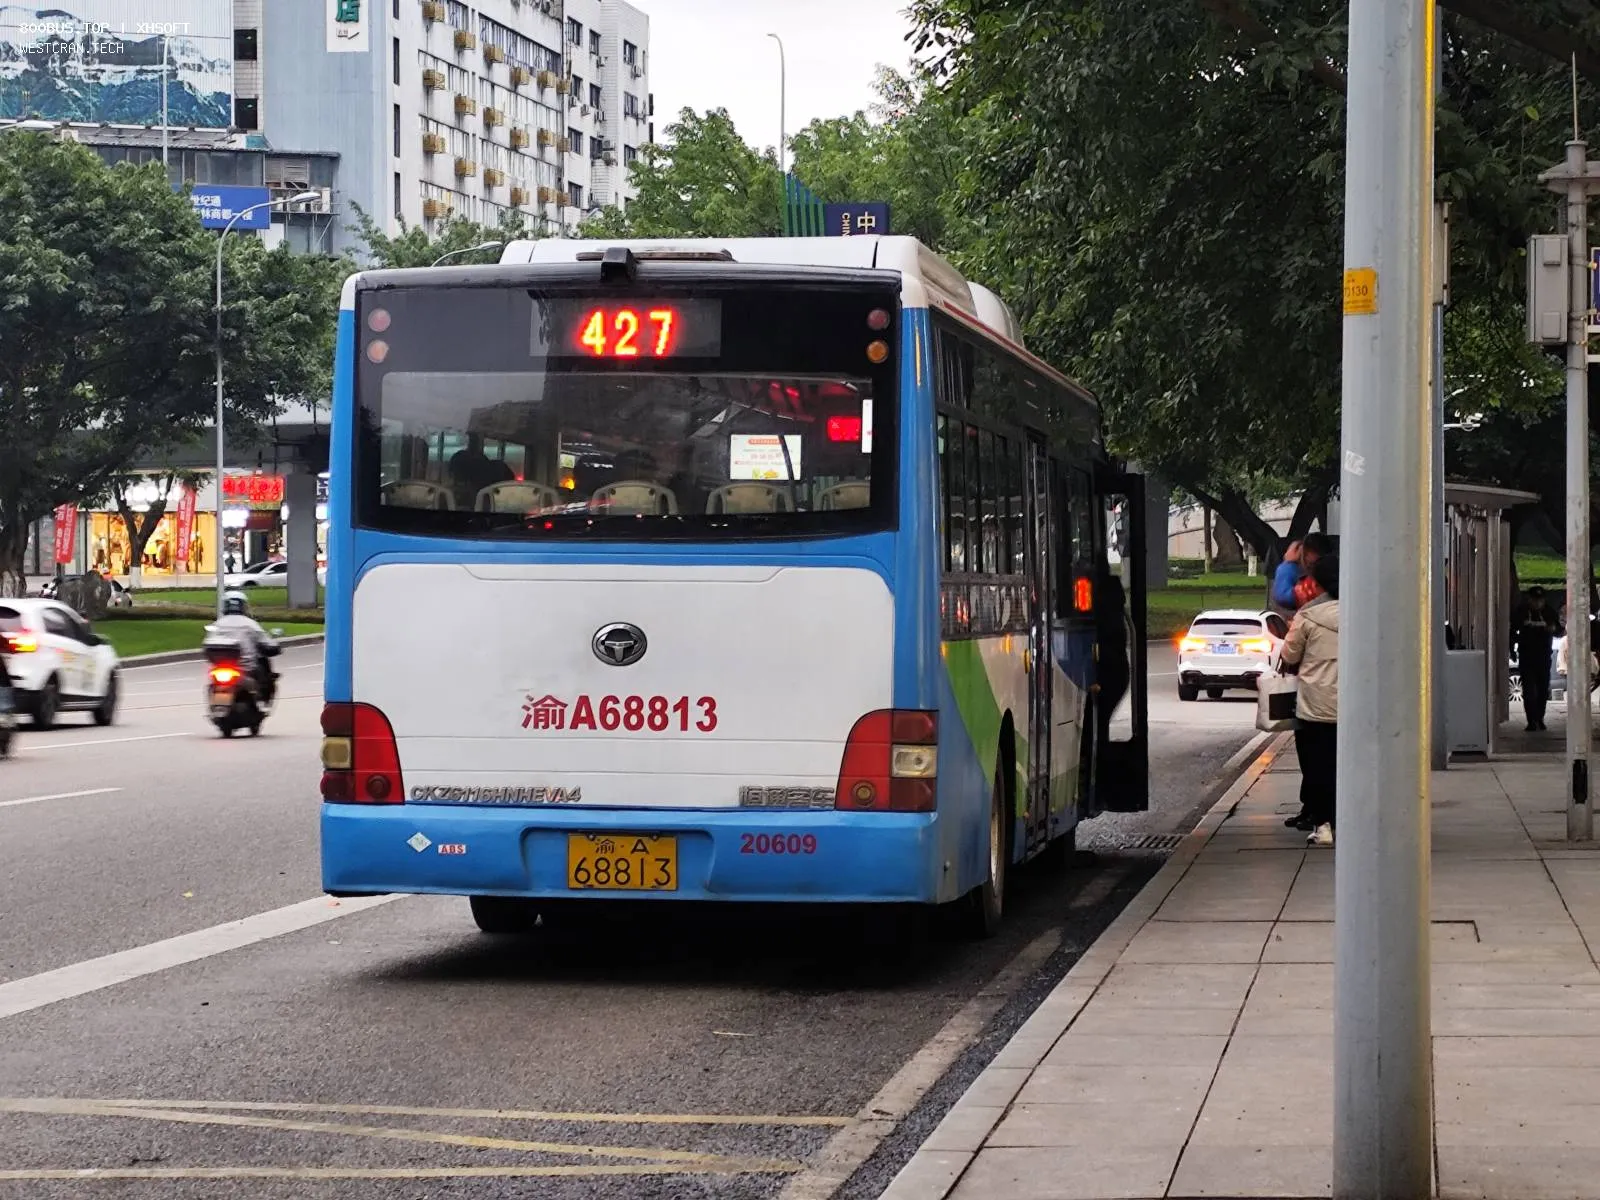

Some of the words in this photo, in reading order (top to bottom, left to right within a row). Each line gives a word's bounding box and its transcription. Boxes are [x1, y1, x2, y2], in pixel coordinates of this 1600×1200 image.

[857, 211, 876, 235] 中
[582, 310, 673, 356] 427
[521, 694, 718, 732] 渝A68813
[441, 845, 464, 853] ABS
[740, 833, 818, 855] 20609
[574, 857, 671, 886] 68813
